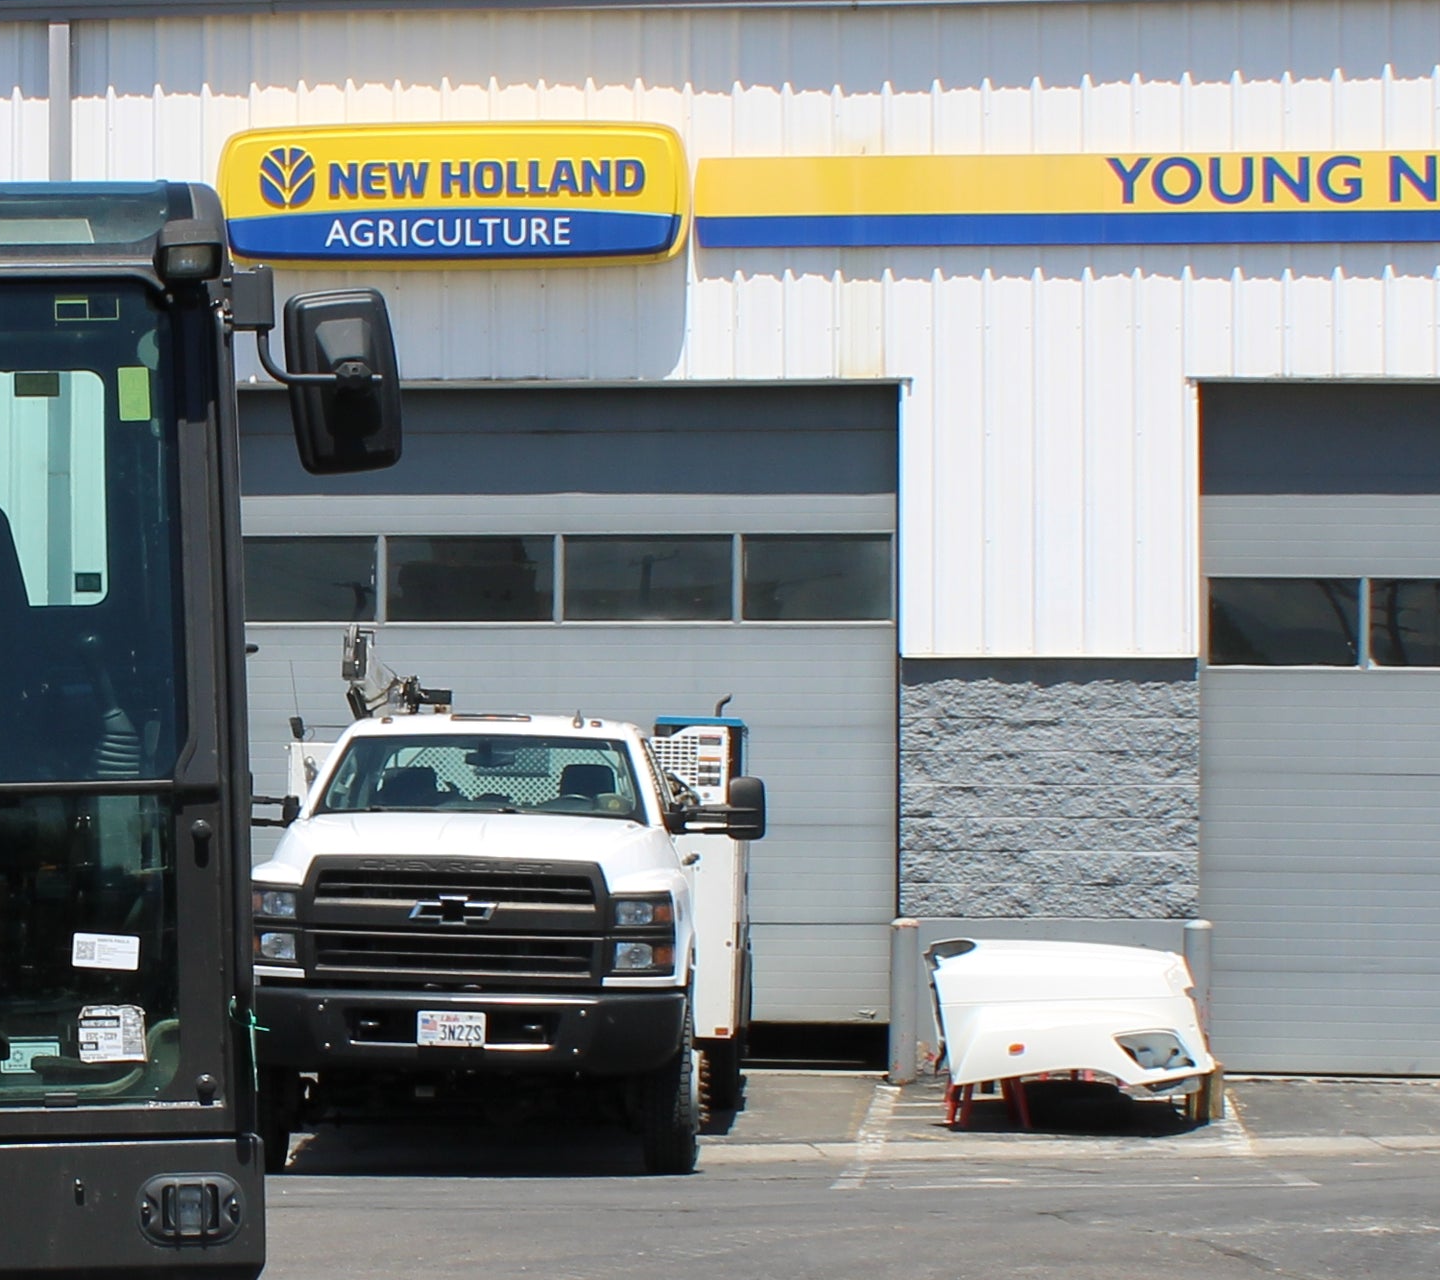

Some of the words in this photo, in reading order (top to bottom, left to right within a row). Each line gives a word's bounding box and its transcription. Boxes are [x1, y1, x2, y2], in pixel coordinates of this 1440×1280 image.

[328, 160, 430, 198] NEW
[440, 158, 646, 197] HOLLAND
[1106, 155, 1363, 204] YOUNG
[325, 217, 571, 247] AGRICULTURE
[359, 859, 553, 874] CHEVROLET
